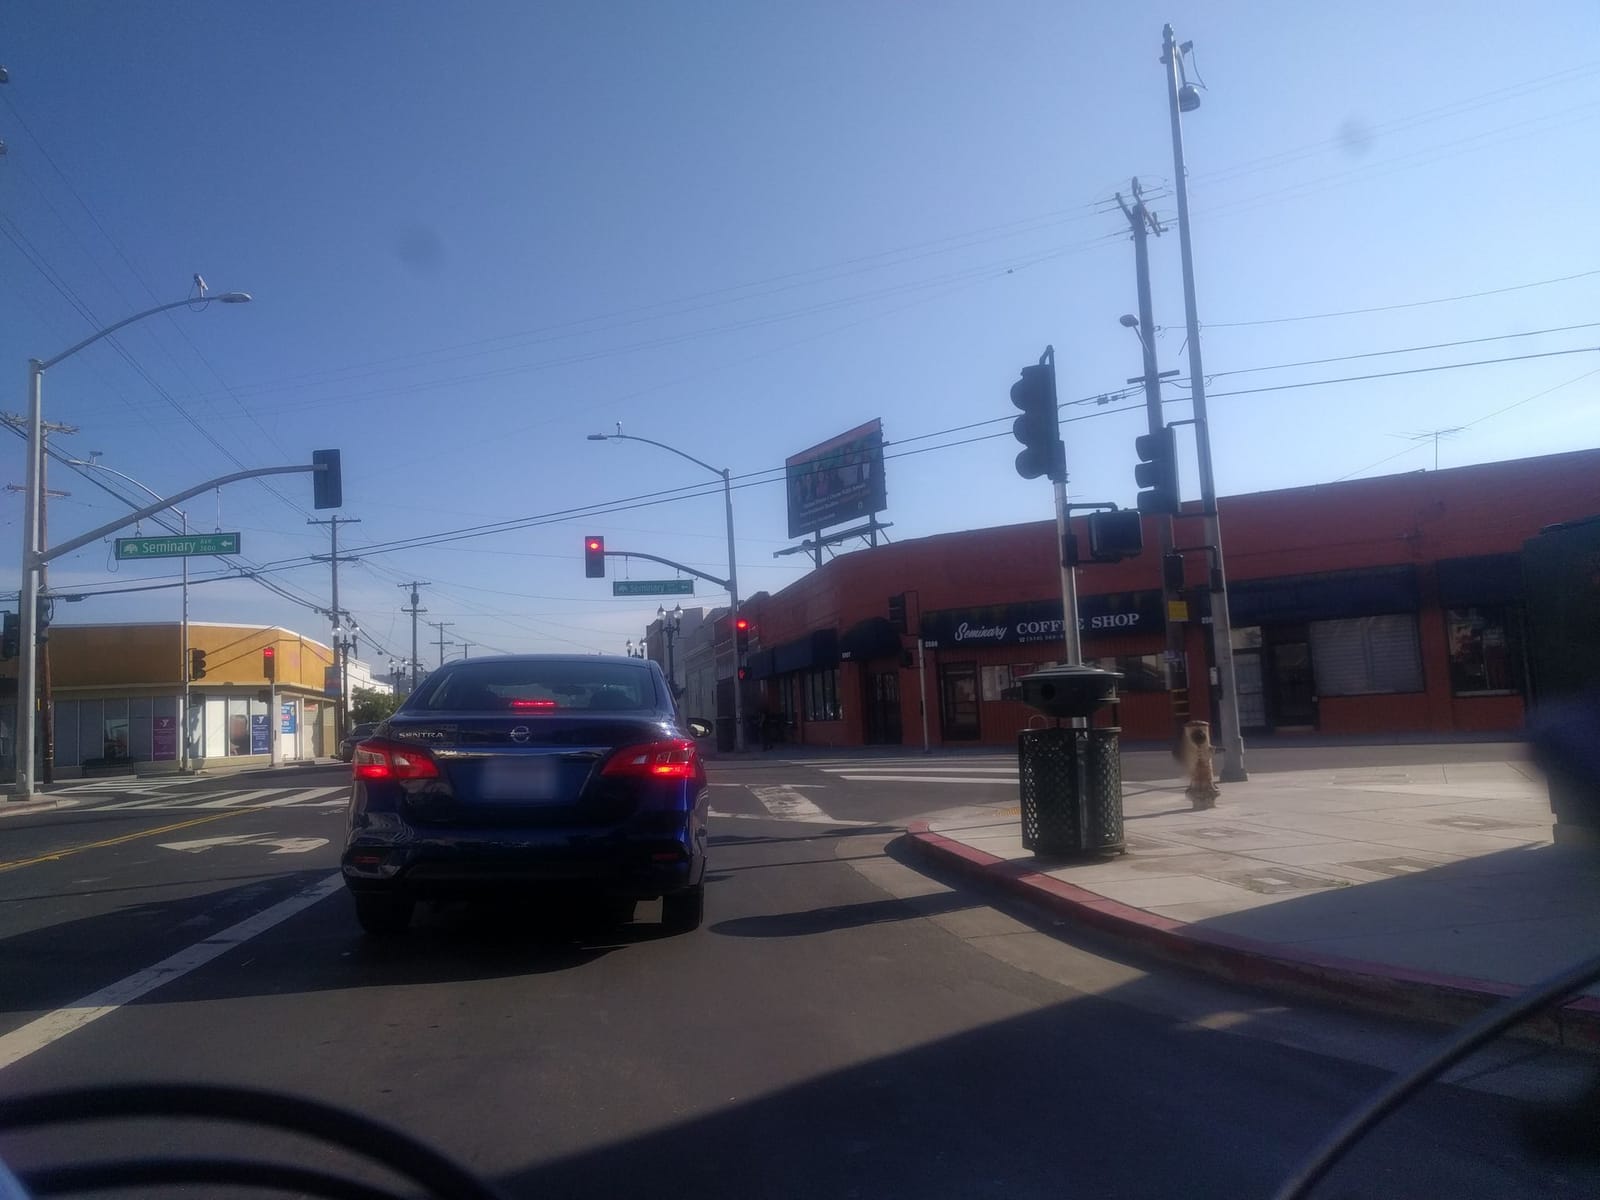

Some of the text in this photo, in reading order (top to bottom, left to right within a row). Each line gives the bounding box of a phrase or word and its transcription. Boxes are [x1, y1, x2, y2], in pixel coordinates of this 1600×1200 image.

[142, 541, 196, 554] Seminary
[954, 622, 1007, 641] Seminary
[1016, 618, 1085, 634] COFFE
[1091, 613, 1140, 629] SHOP
